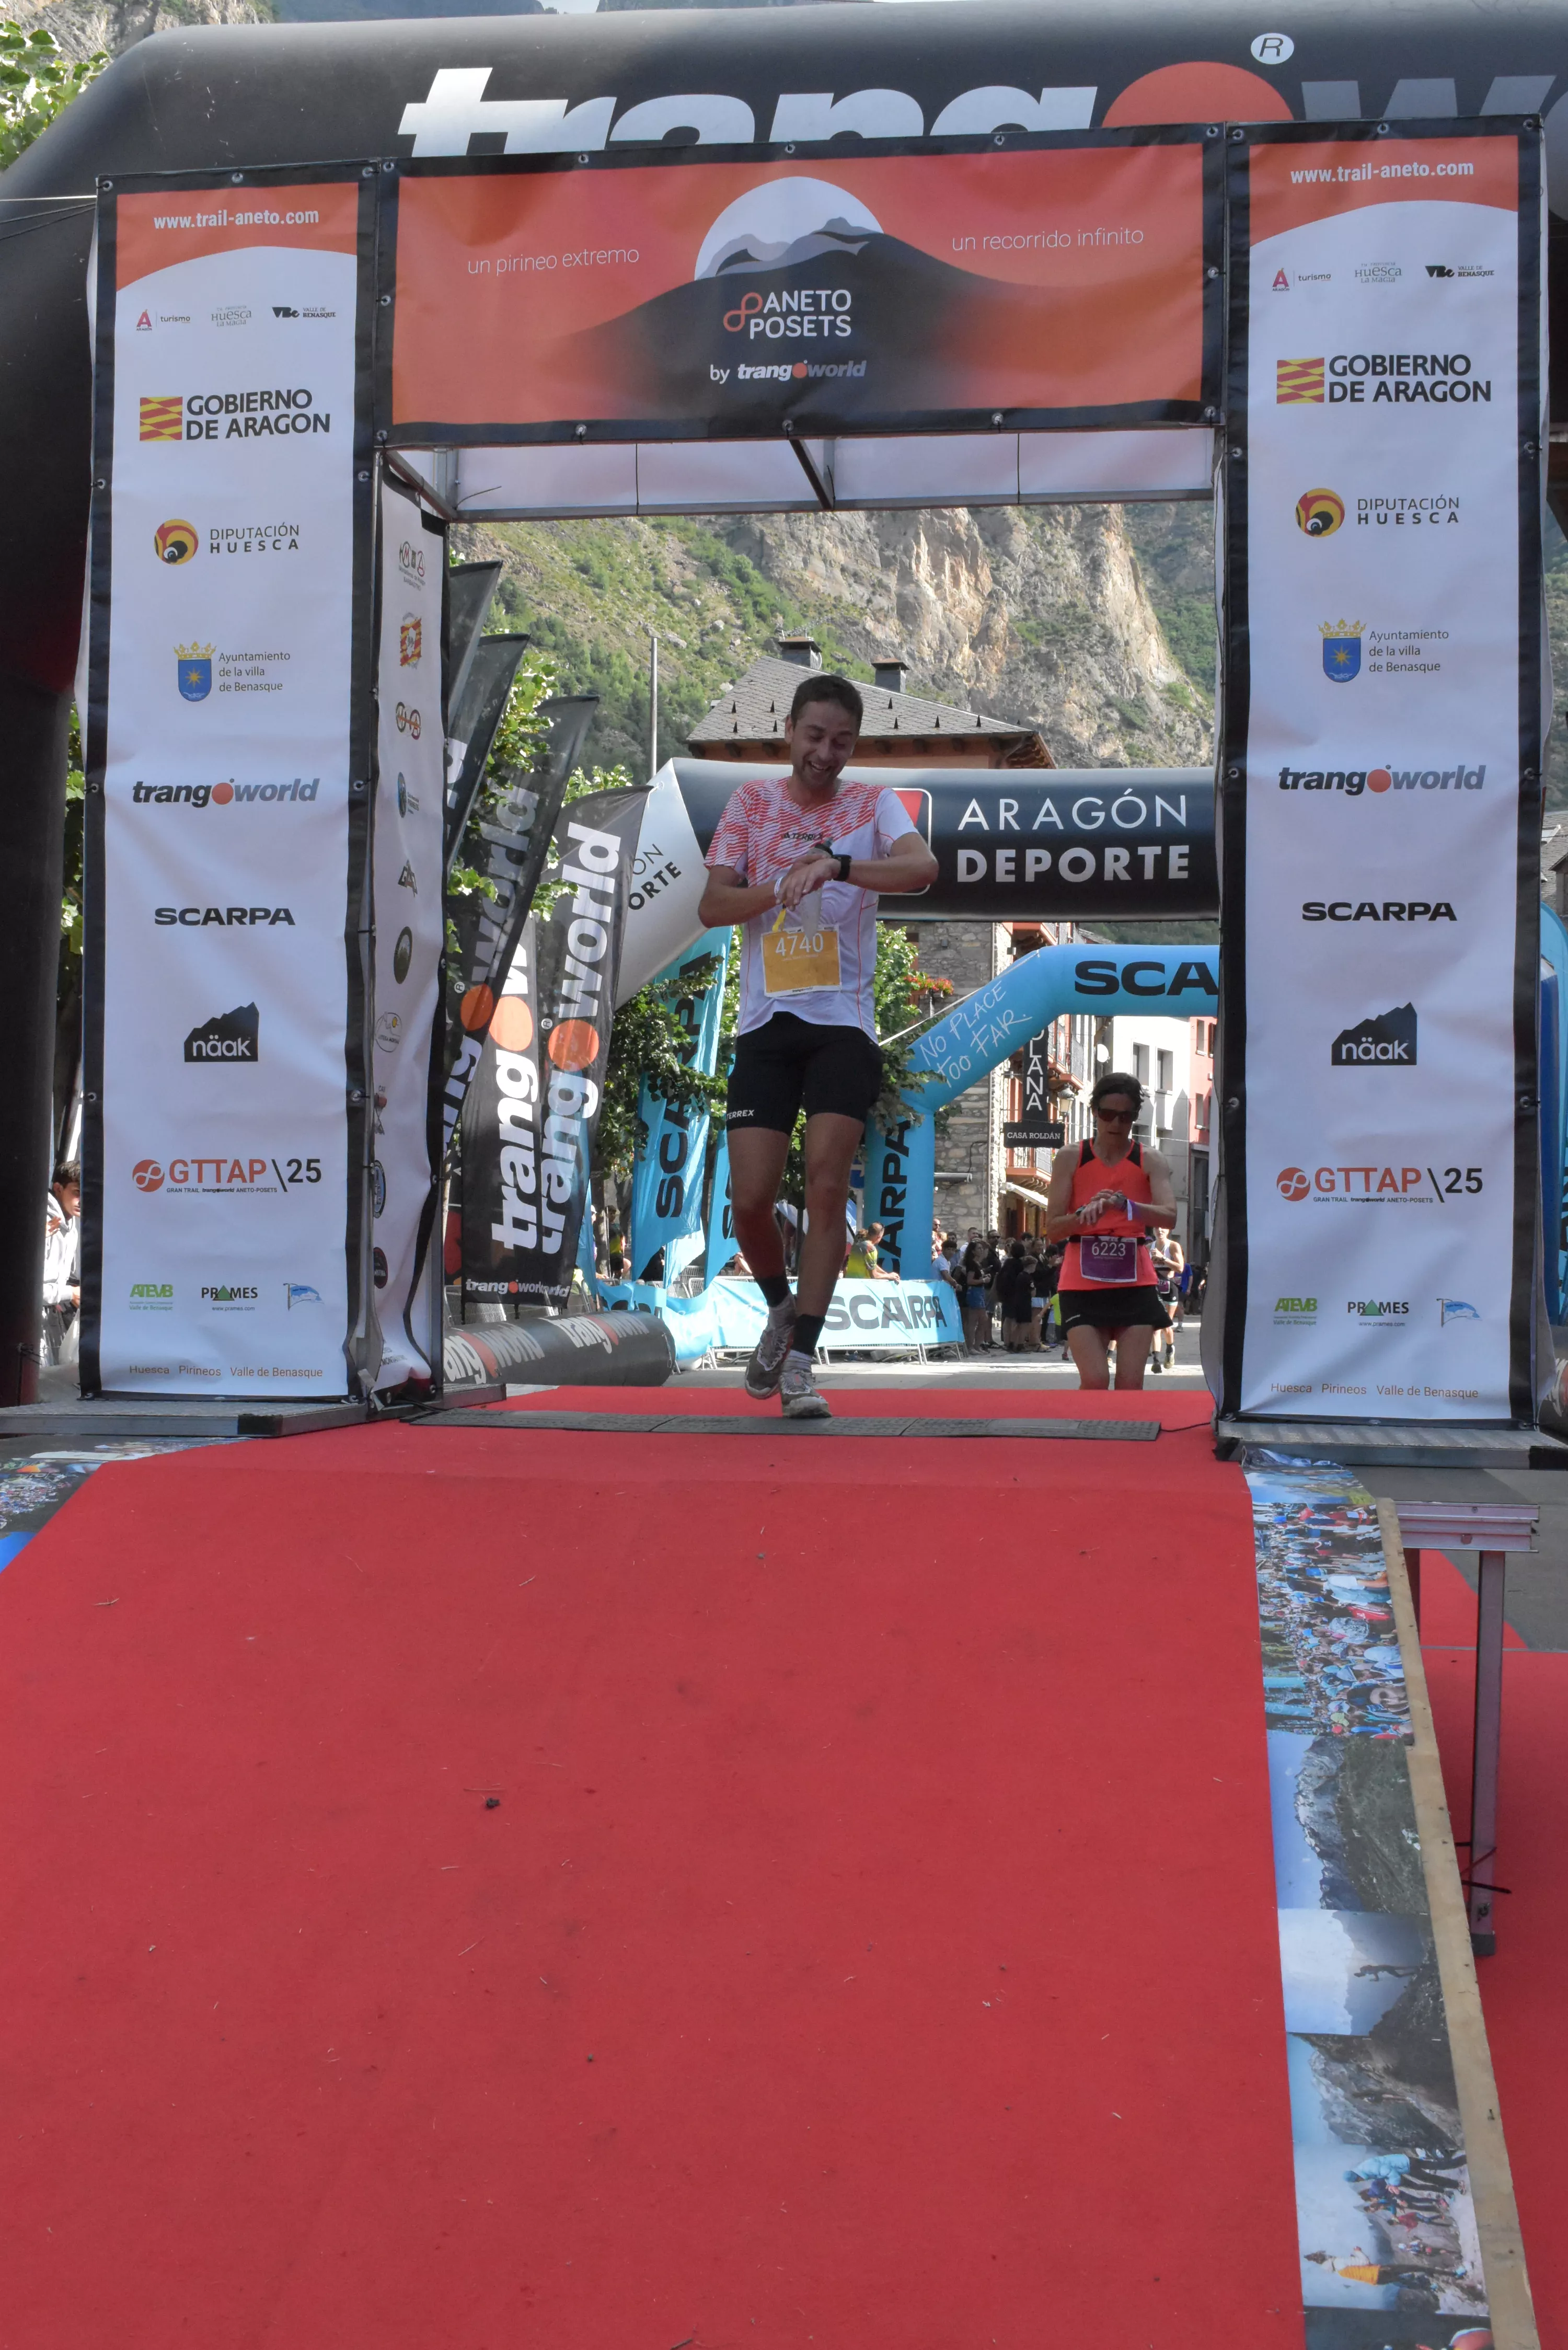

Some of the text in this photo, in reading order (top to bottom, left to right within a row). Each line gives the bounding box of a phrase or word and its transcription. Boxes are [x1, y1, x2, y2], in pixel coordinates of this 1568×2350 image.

[1290, 162, 1474, 184] www.trail-aneto.com
[154, 209, 320, 229] www.trail-aneto.com
[952, 226, 1144, 251] un recorrido infinito
[467, 245, 639, 277] un pirineo extremo
[1298, 273, 1331, 282] turismo
[763, 289, 851, 313] ANETO
[750, 314, 851, 339] POSETS
[710, 363, 730, 384] by
[1329, 354, 1471, 377] GOBIERNO
[1329, 380, 1491, 403] DE ARAGON
[187, 388, 313, 416] GOBIERNO
[186, 413, 330, 440] DE ARAGON
[1357, 494, 1459, 511] DIPUTACIÓN
[1358, 512, 1459, 525] HUESCA
[210, 522, 299, 540] DIPUTACIÓN
[210, 538, 299, 554] HUESCA
[1369, 629, 1449, 643] Ayuntamiento
[218, 651, 291, 663] Ayuntamiento
[1369, 646, 1421, 656] de la villa
[219, 666, 265, 677] de la villa
[1369, 661, 1440, 674] de Benasque
[219, 682, 283, 693] de Benasque
[958, 788, 1187, 831] ARAGÓN
[957, 845, 1190, 883] DEPORTE
[629, 861, 682, 910] ORTE
[154, 907, 296, 926] SCARPA
[1301, 902, 1458, 921] SCARPA
[775, 932, 824, 957] 4740
[1074, 960, 1219, 996] SCA
[920, 980, 1007, 1067] NO PLACE
[193, 1034, 251, 1056] näak
[1342, 1036, 1409, 1060] näak
[937, 1055, 972, 1088] TOO
[1029, 1131, 1060, 1139] ROLDÁN
[1091, 1242, 1126, 1257] 6223
[130, 1284, 174, 1298] ATEVB
[201, 1285, 258, 1300] PRAMES
[824, 1294, 948, 1331] SCARPA
[1274, 1297, 1318, 1312] ATEVB
[1347, 1300, 1409, 1315] PRAMES
[129, 1365, 323, 1379] Huesca Pirineos Valle de Benasque
[1271, 1383, 1479, 1400] Huesca Pirineos Valle de Benasque
